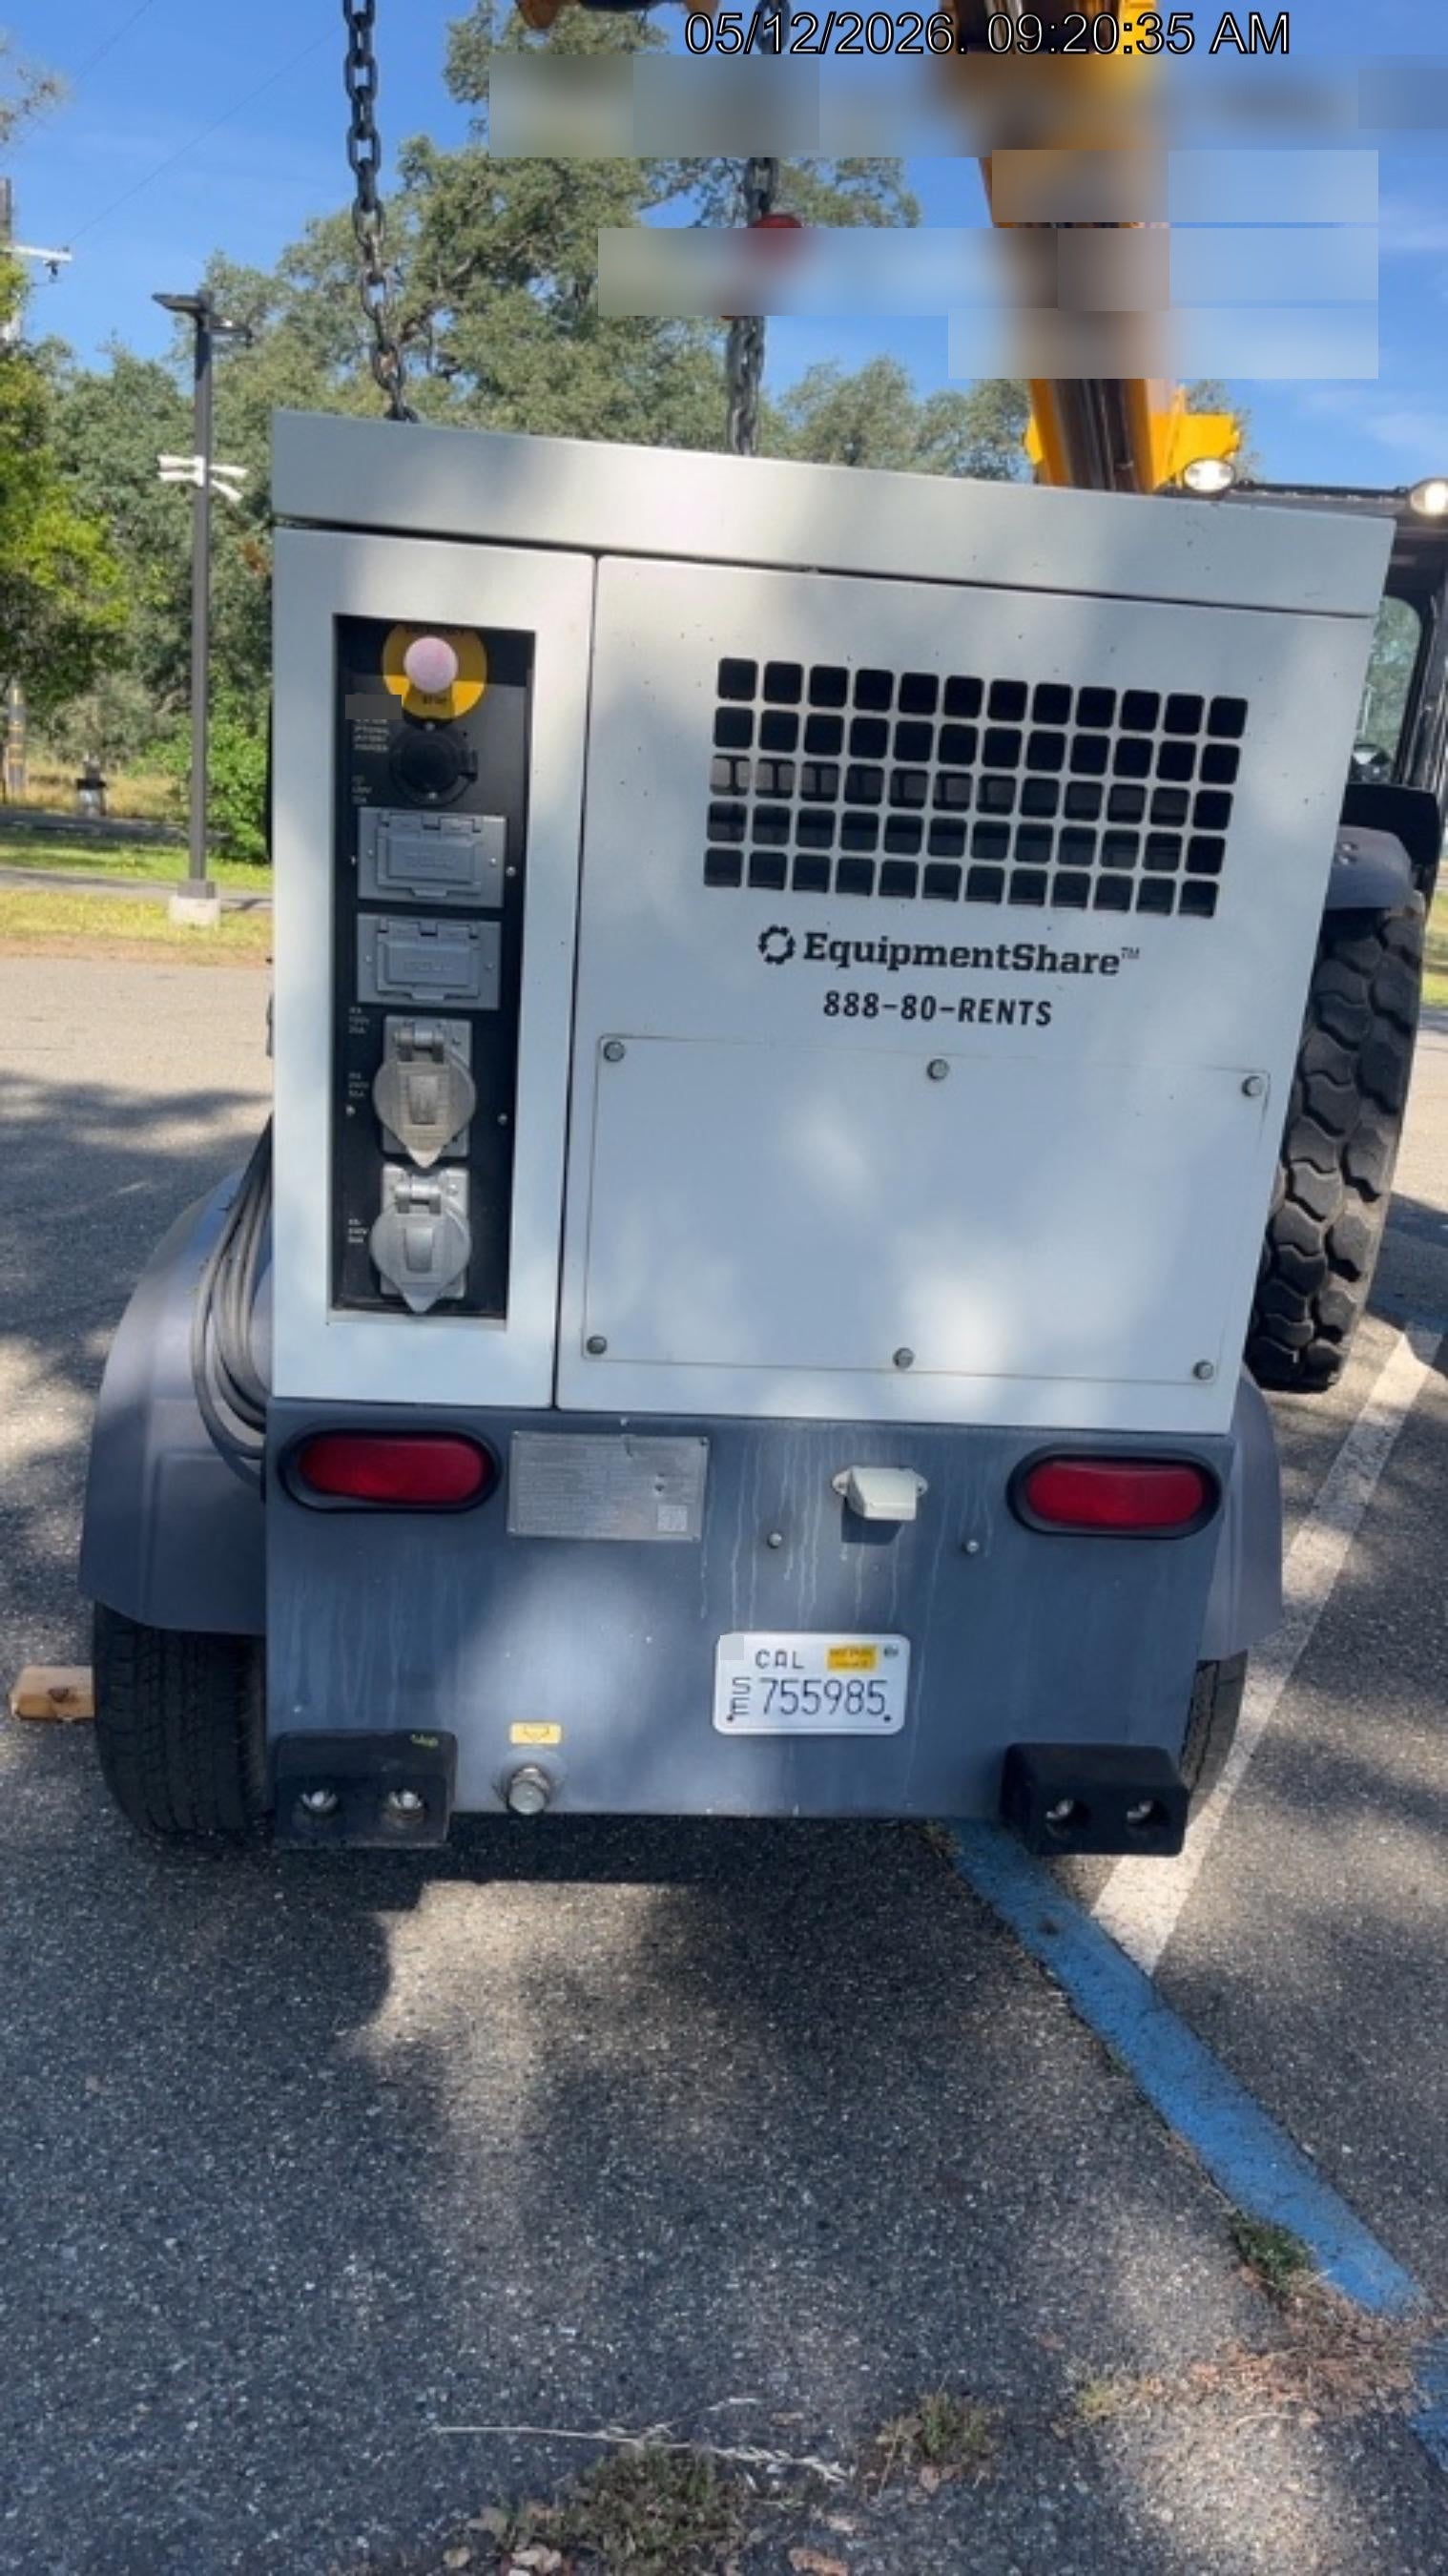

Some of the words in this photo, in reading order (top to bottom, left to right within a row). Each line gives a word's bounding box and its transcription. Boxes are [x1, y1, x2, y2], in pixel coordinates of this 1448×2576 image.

[823, 989, 1052, 1028] 888-80-RENTS
[755, 1649, 805, 1670] CAL
[758, 1676, 888, 1716] 755985
